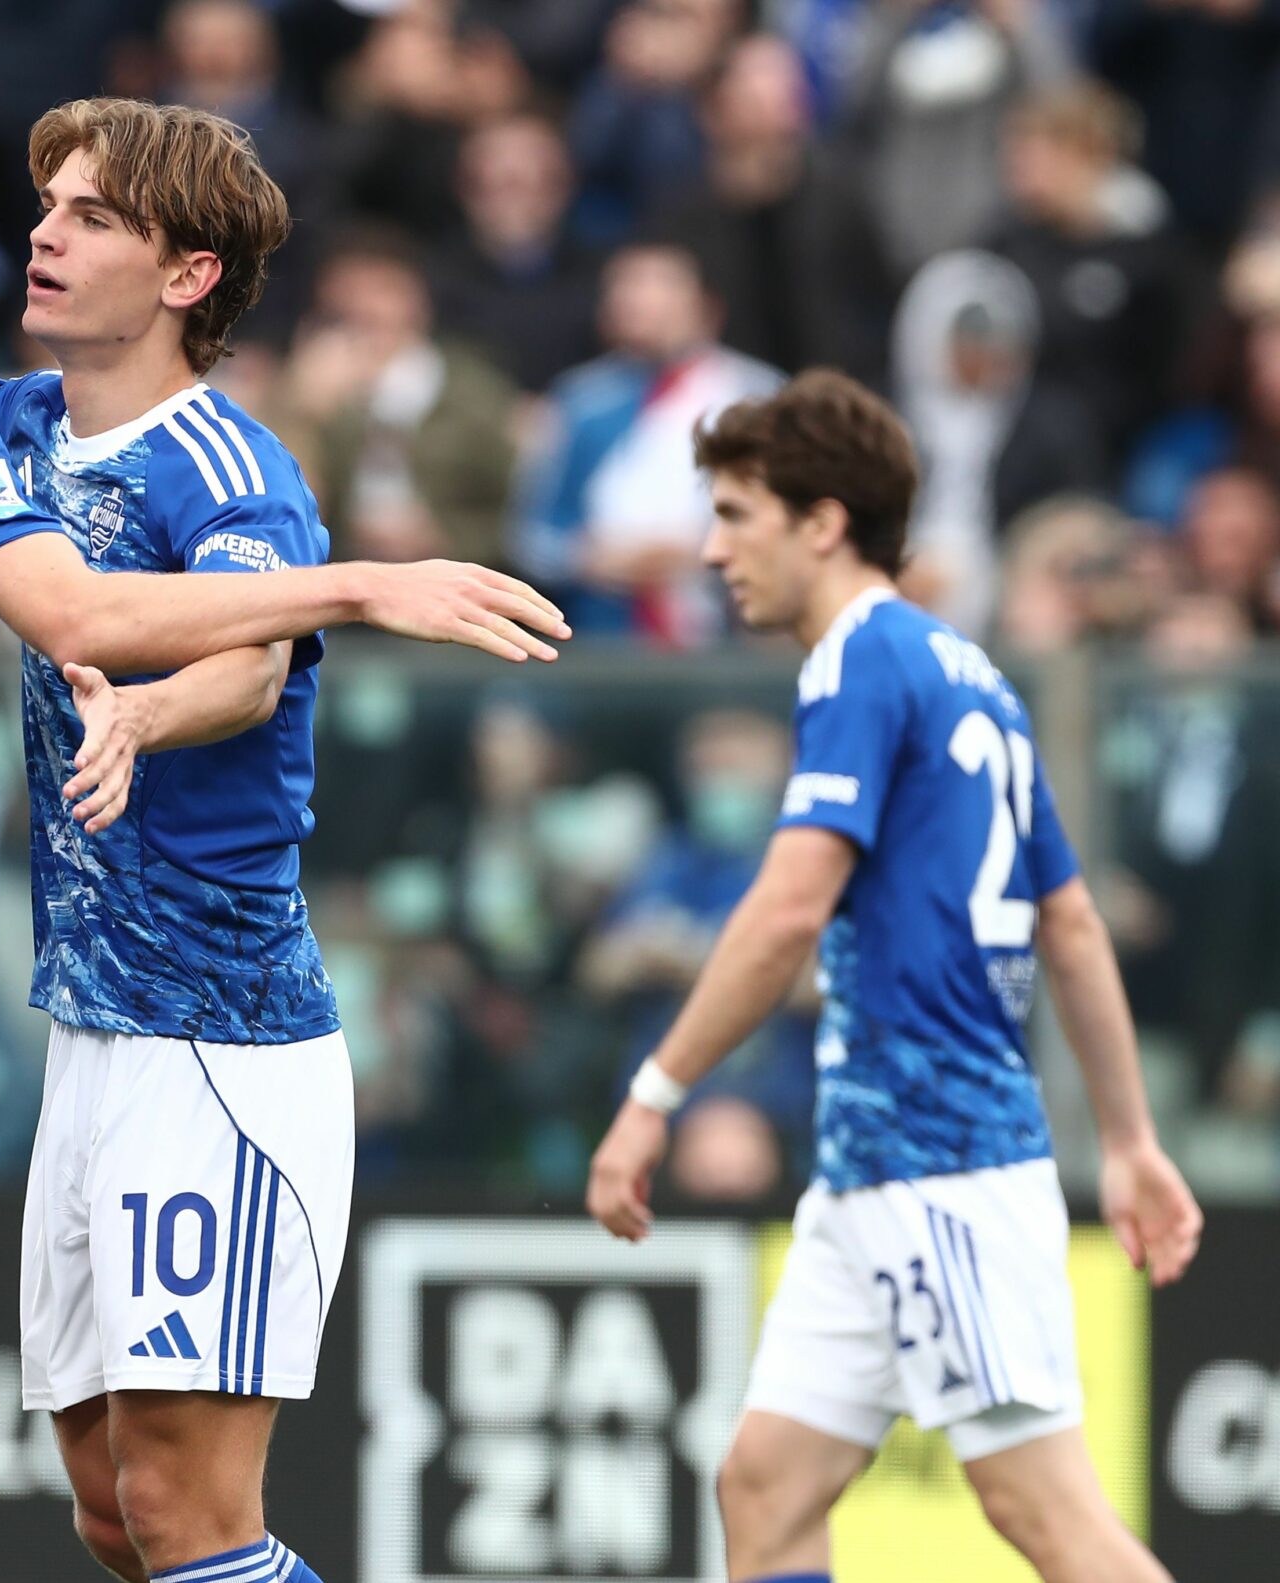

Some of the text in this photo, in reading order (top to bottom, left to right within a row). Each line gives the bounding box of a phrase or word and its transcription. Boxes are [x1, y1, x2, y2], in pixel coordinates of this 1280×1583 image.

[94, 506, 118, 530] COMO
[228, 553, 268, 573] NEWS
[122, 1191, 218, 1298] 10
[446, 1286, 676, 1416] DA
[874, 1257, 944, 1350] 23
[448, 1436, 671, 1574] ZN
